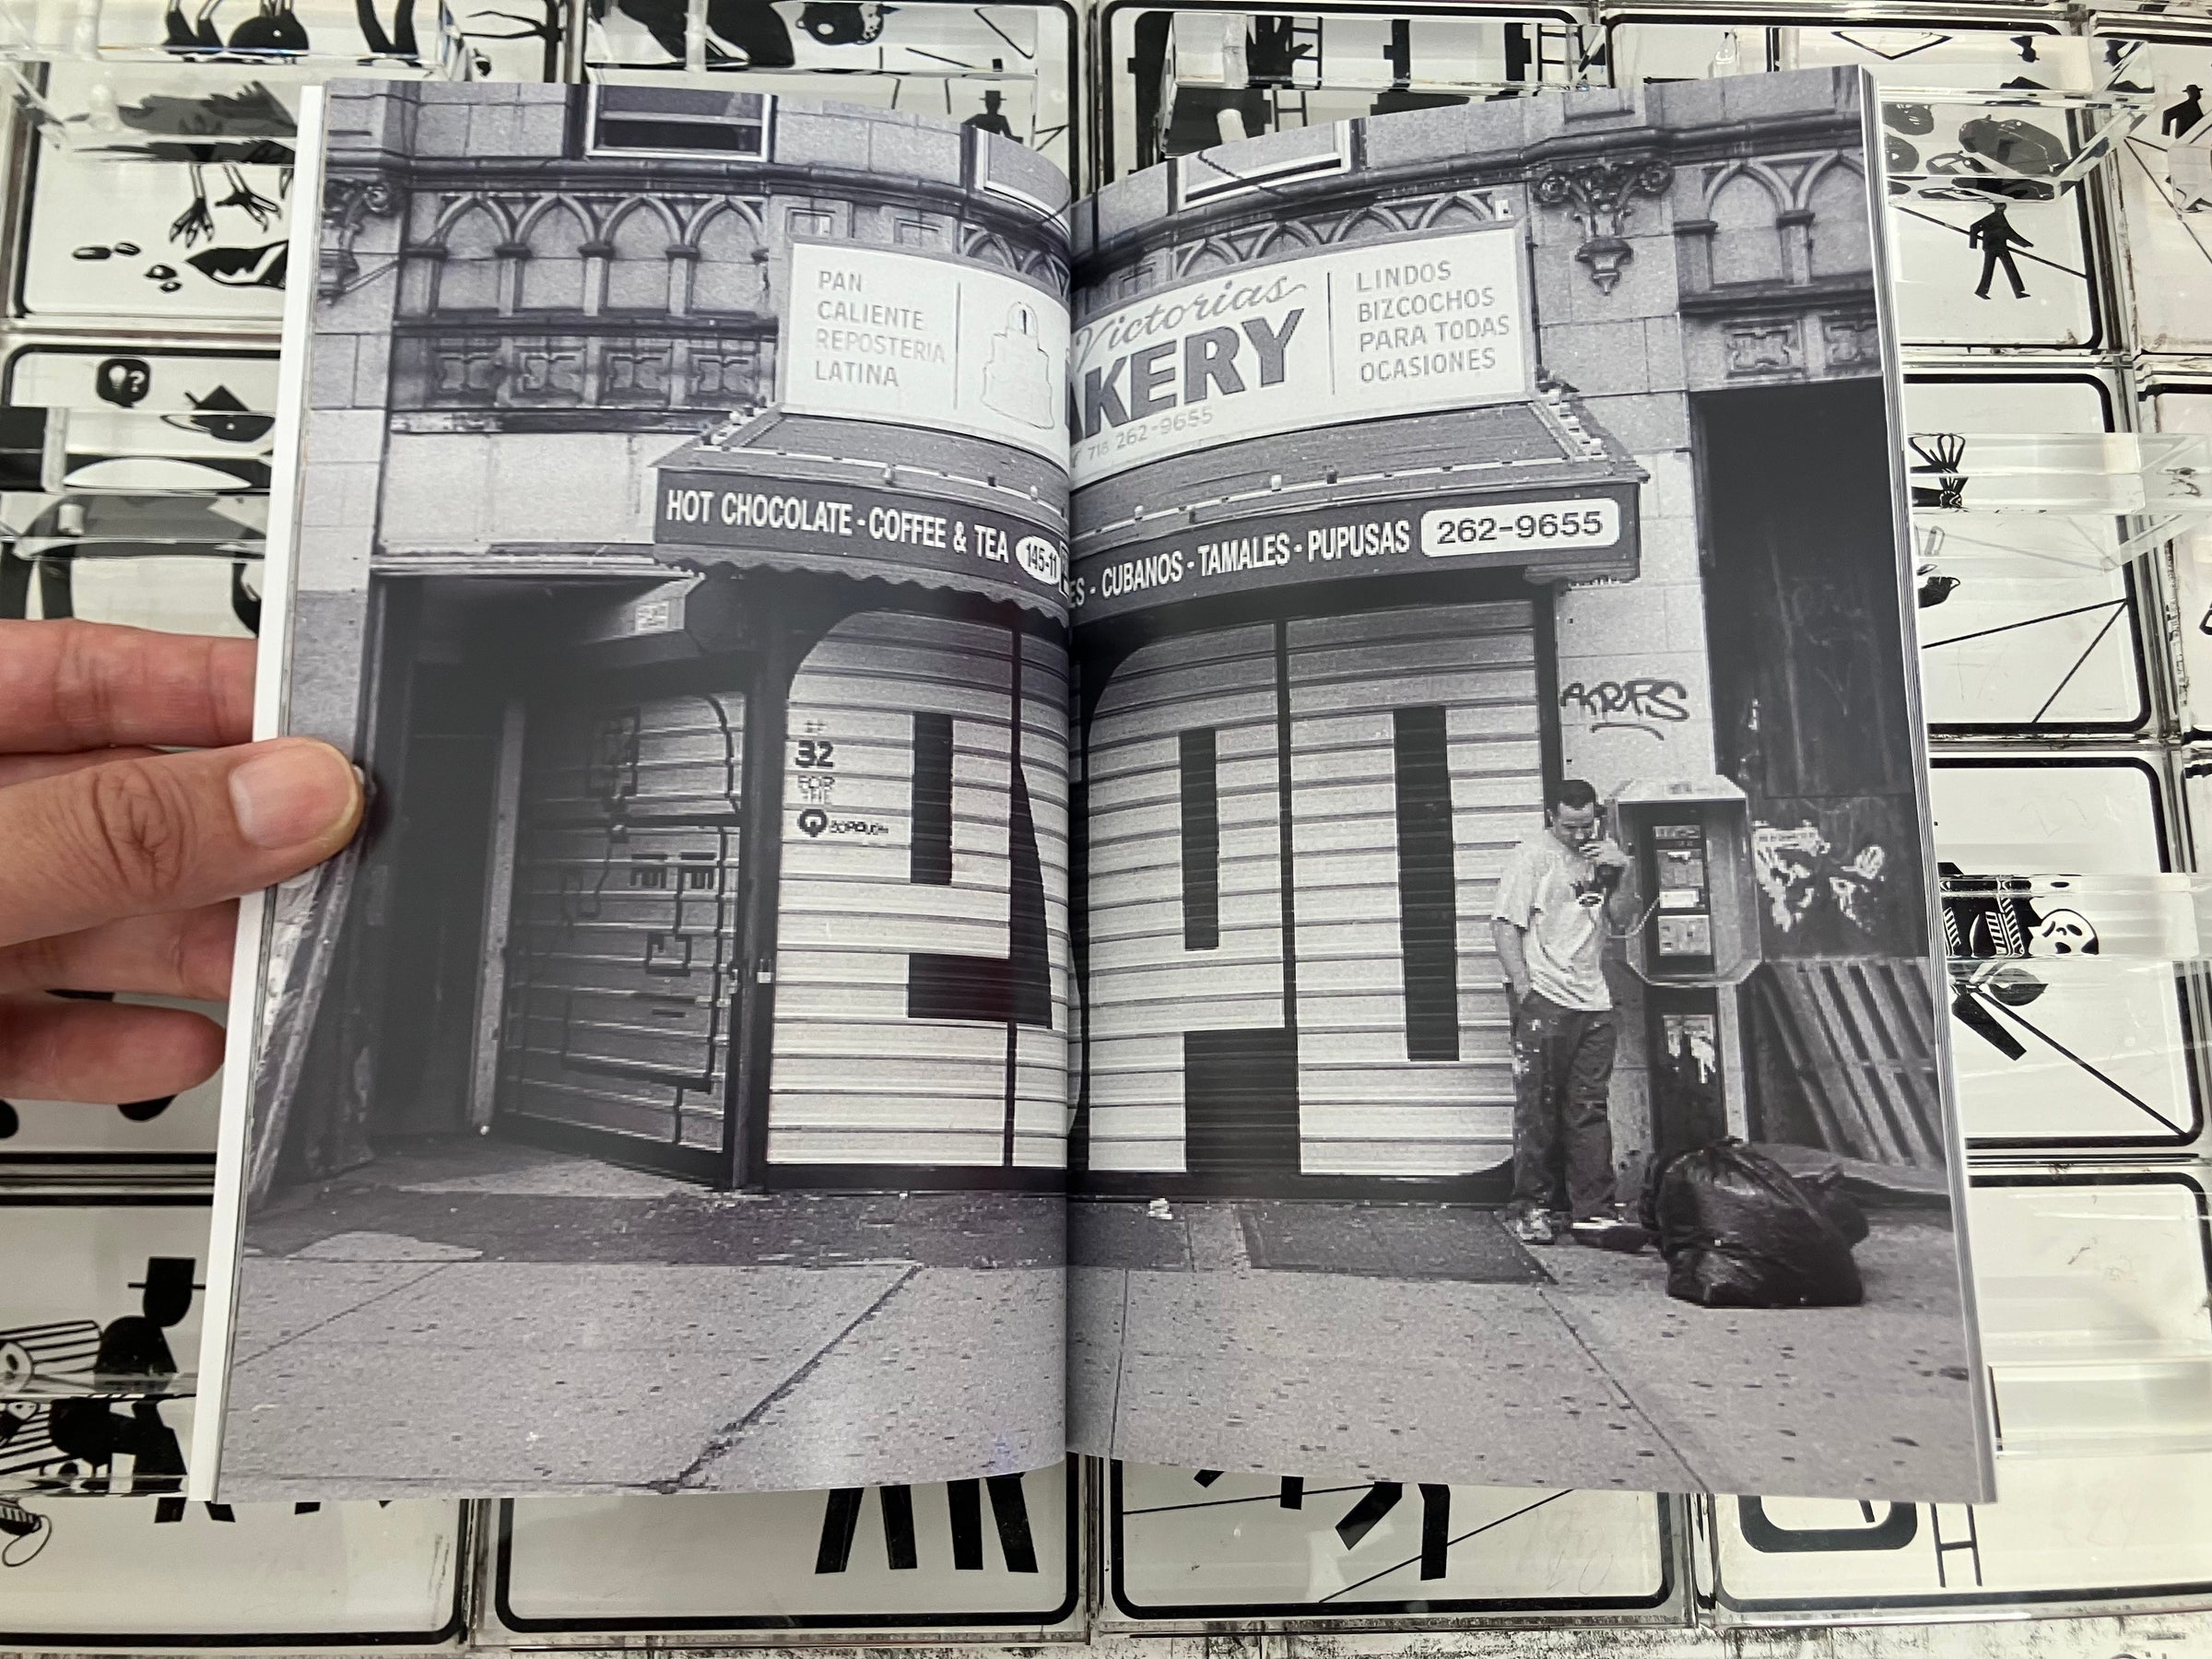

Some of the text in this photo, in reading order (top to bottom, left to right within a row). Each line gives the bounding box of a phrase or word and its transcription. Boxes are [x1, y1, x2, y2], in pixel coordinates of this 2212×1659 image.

[818, 271, 862, 292] PAN
[1357, 260, 1452, 292] LINDOS
[818, 300, 924, 331] CALIENTE
[1359, 287, 1495, 323] BIZCOCHOS
[817, 328, 945, 363] REPOSTERIA
[1359, 314, 1510, 352] PARA TODAS
[816, 360, 900, 387] LATINA
[1360, 347, 1496, 383] OCASIONES
[666, 489, 715, 524] HOT
[721, 492, 853, 536] CHOCOLATE
[869, 507, 947, 548] COFFEE
[953, 521, 967, 553] &
[974, 524, 1009, 563] TEA
[1437, 510, 1604, 546] 262-9655
[1102, 550, 1183, 598] CUBANOS
[1198, 532, 1290, 577] TAMALES
[1308, 520, 1411, 562] PUPUSAS
[795, 740, 833, 768] 32
